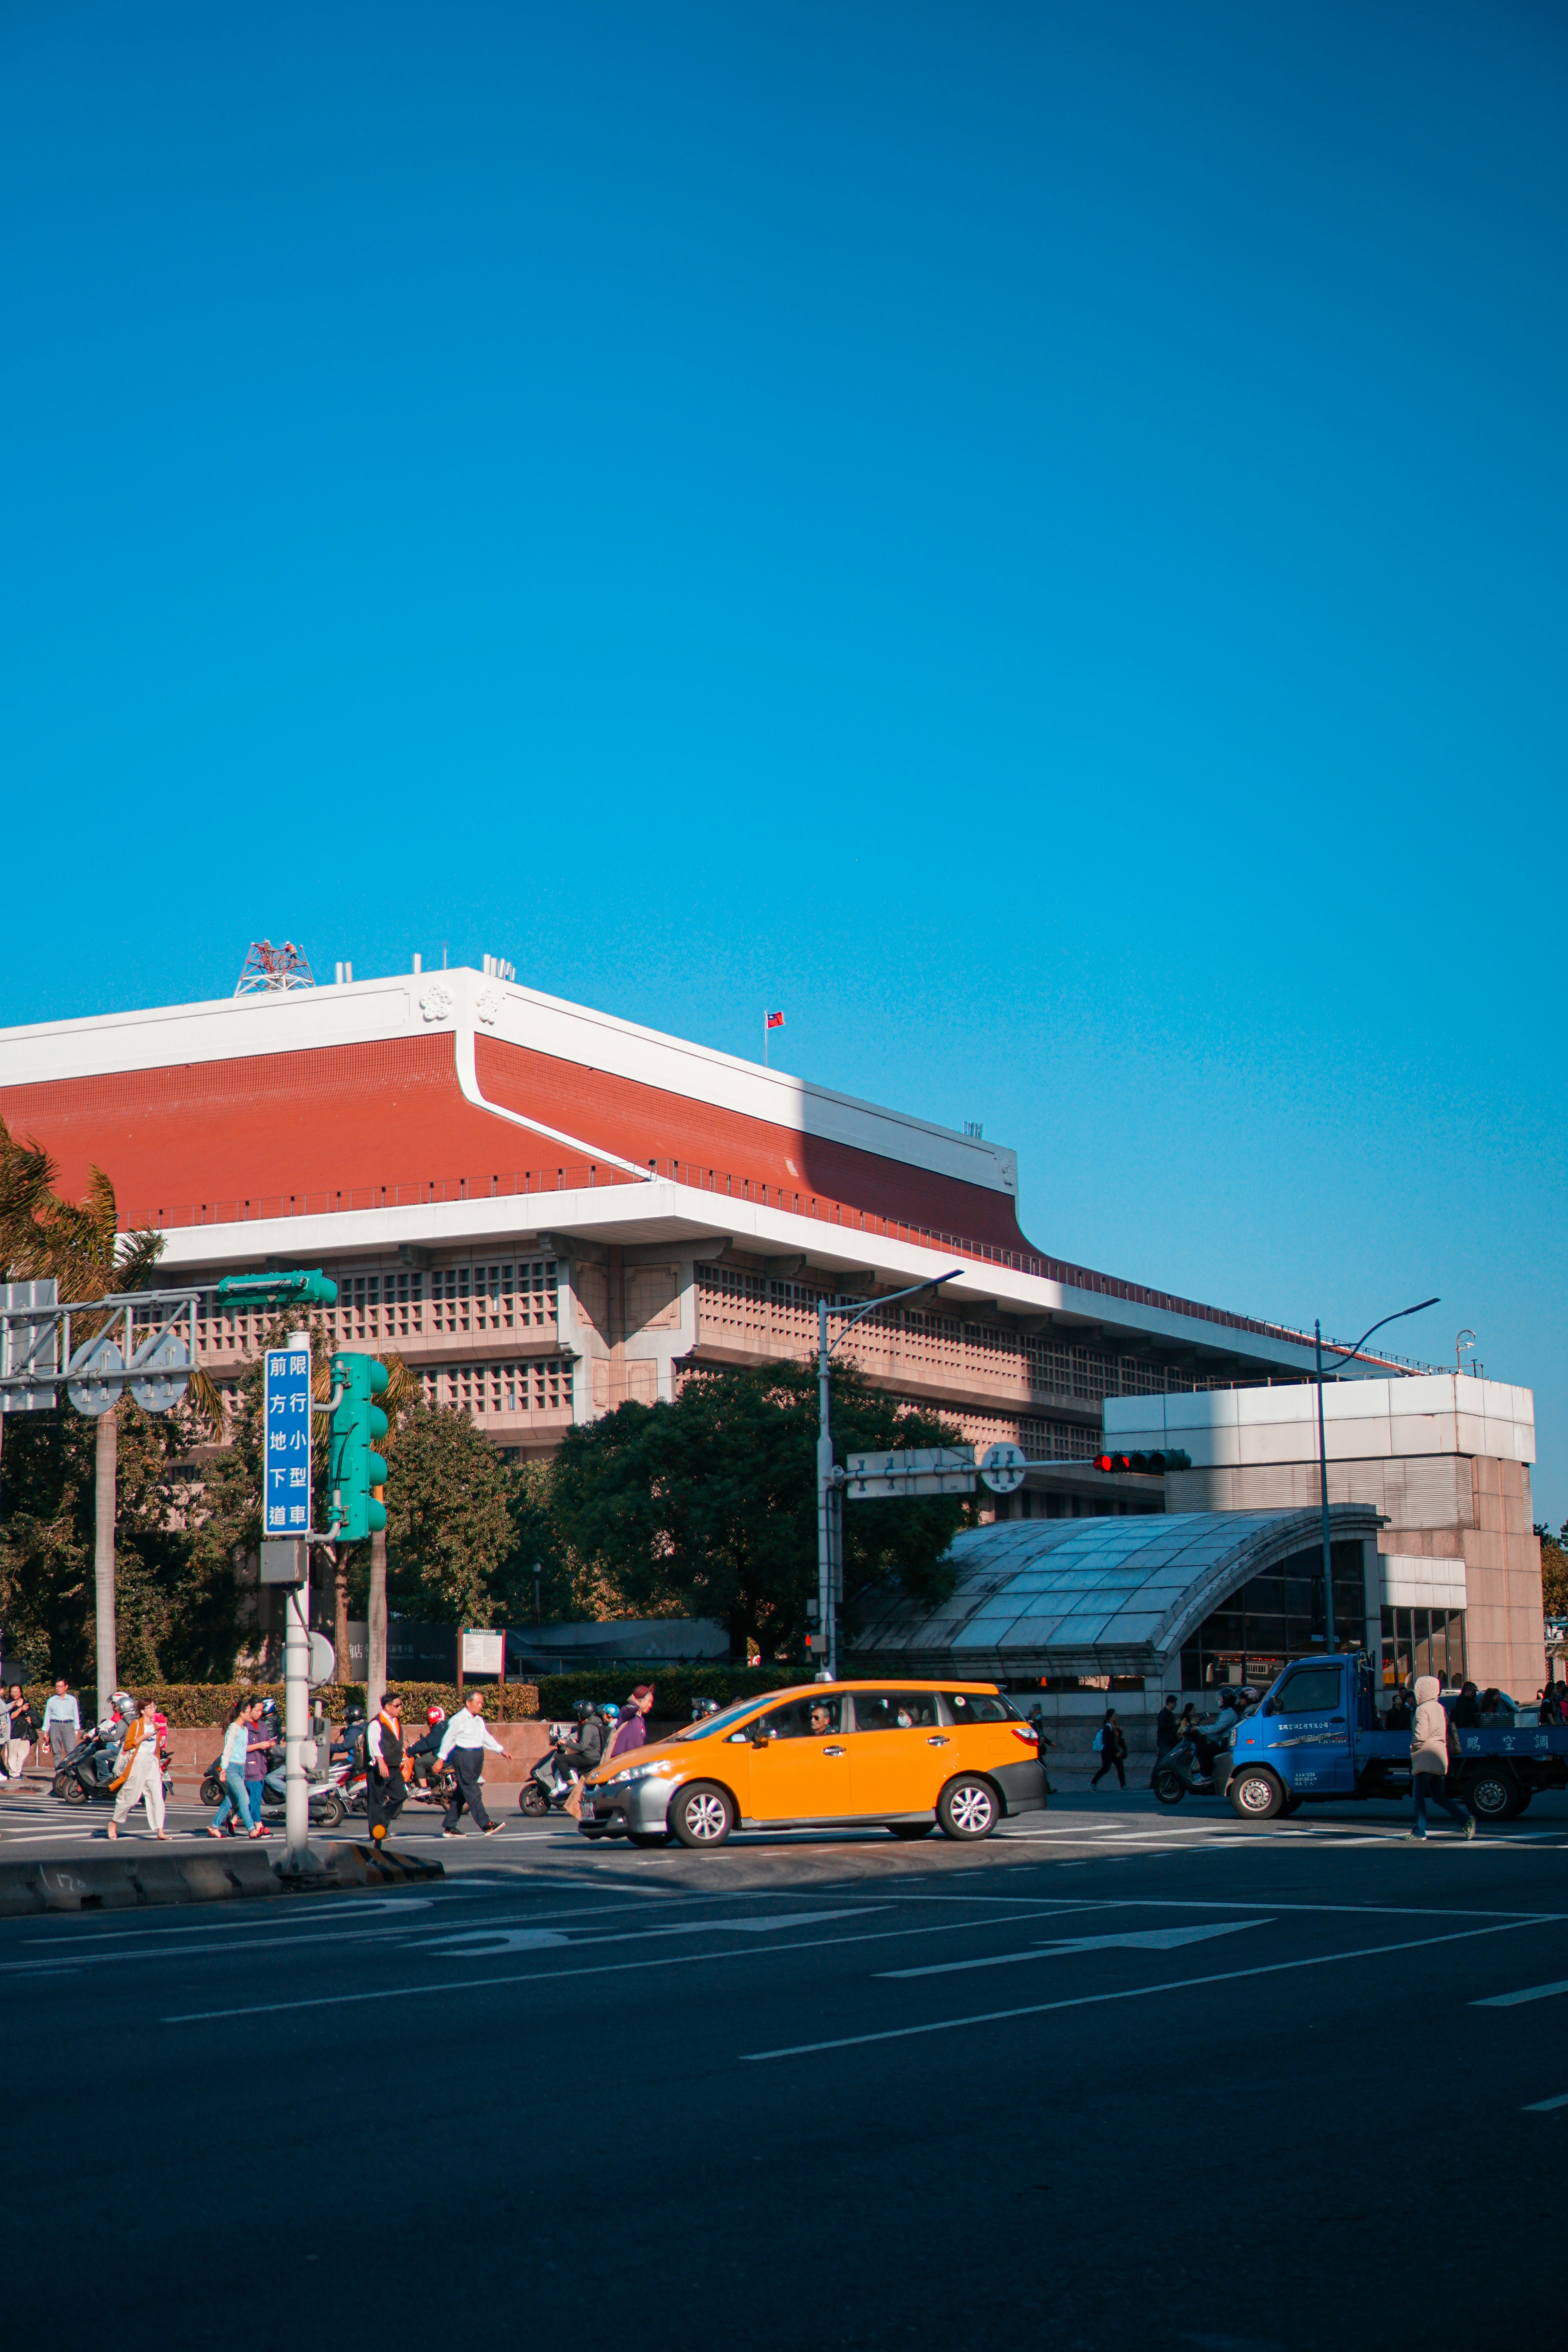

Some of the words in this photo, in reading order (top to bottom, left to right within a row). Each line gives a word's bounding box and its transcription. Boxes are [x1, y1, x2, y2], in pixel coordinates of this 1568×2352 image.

[269, 1357, 287, 1526] 前方地下道
[289, 1356, 307, 1524] 限行小型車
